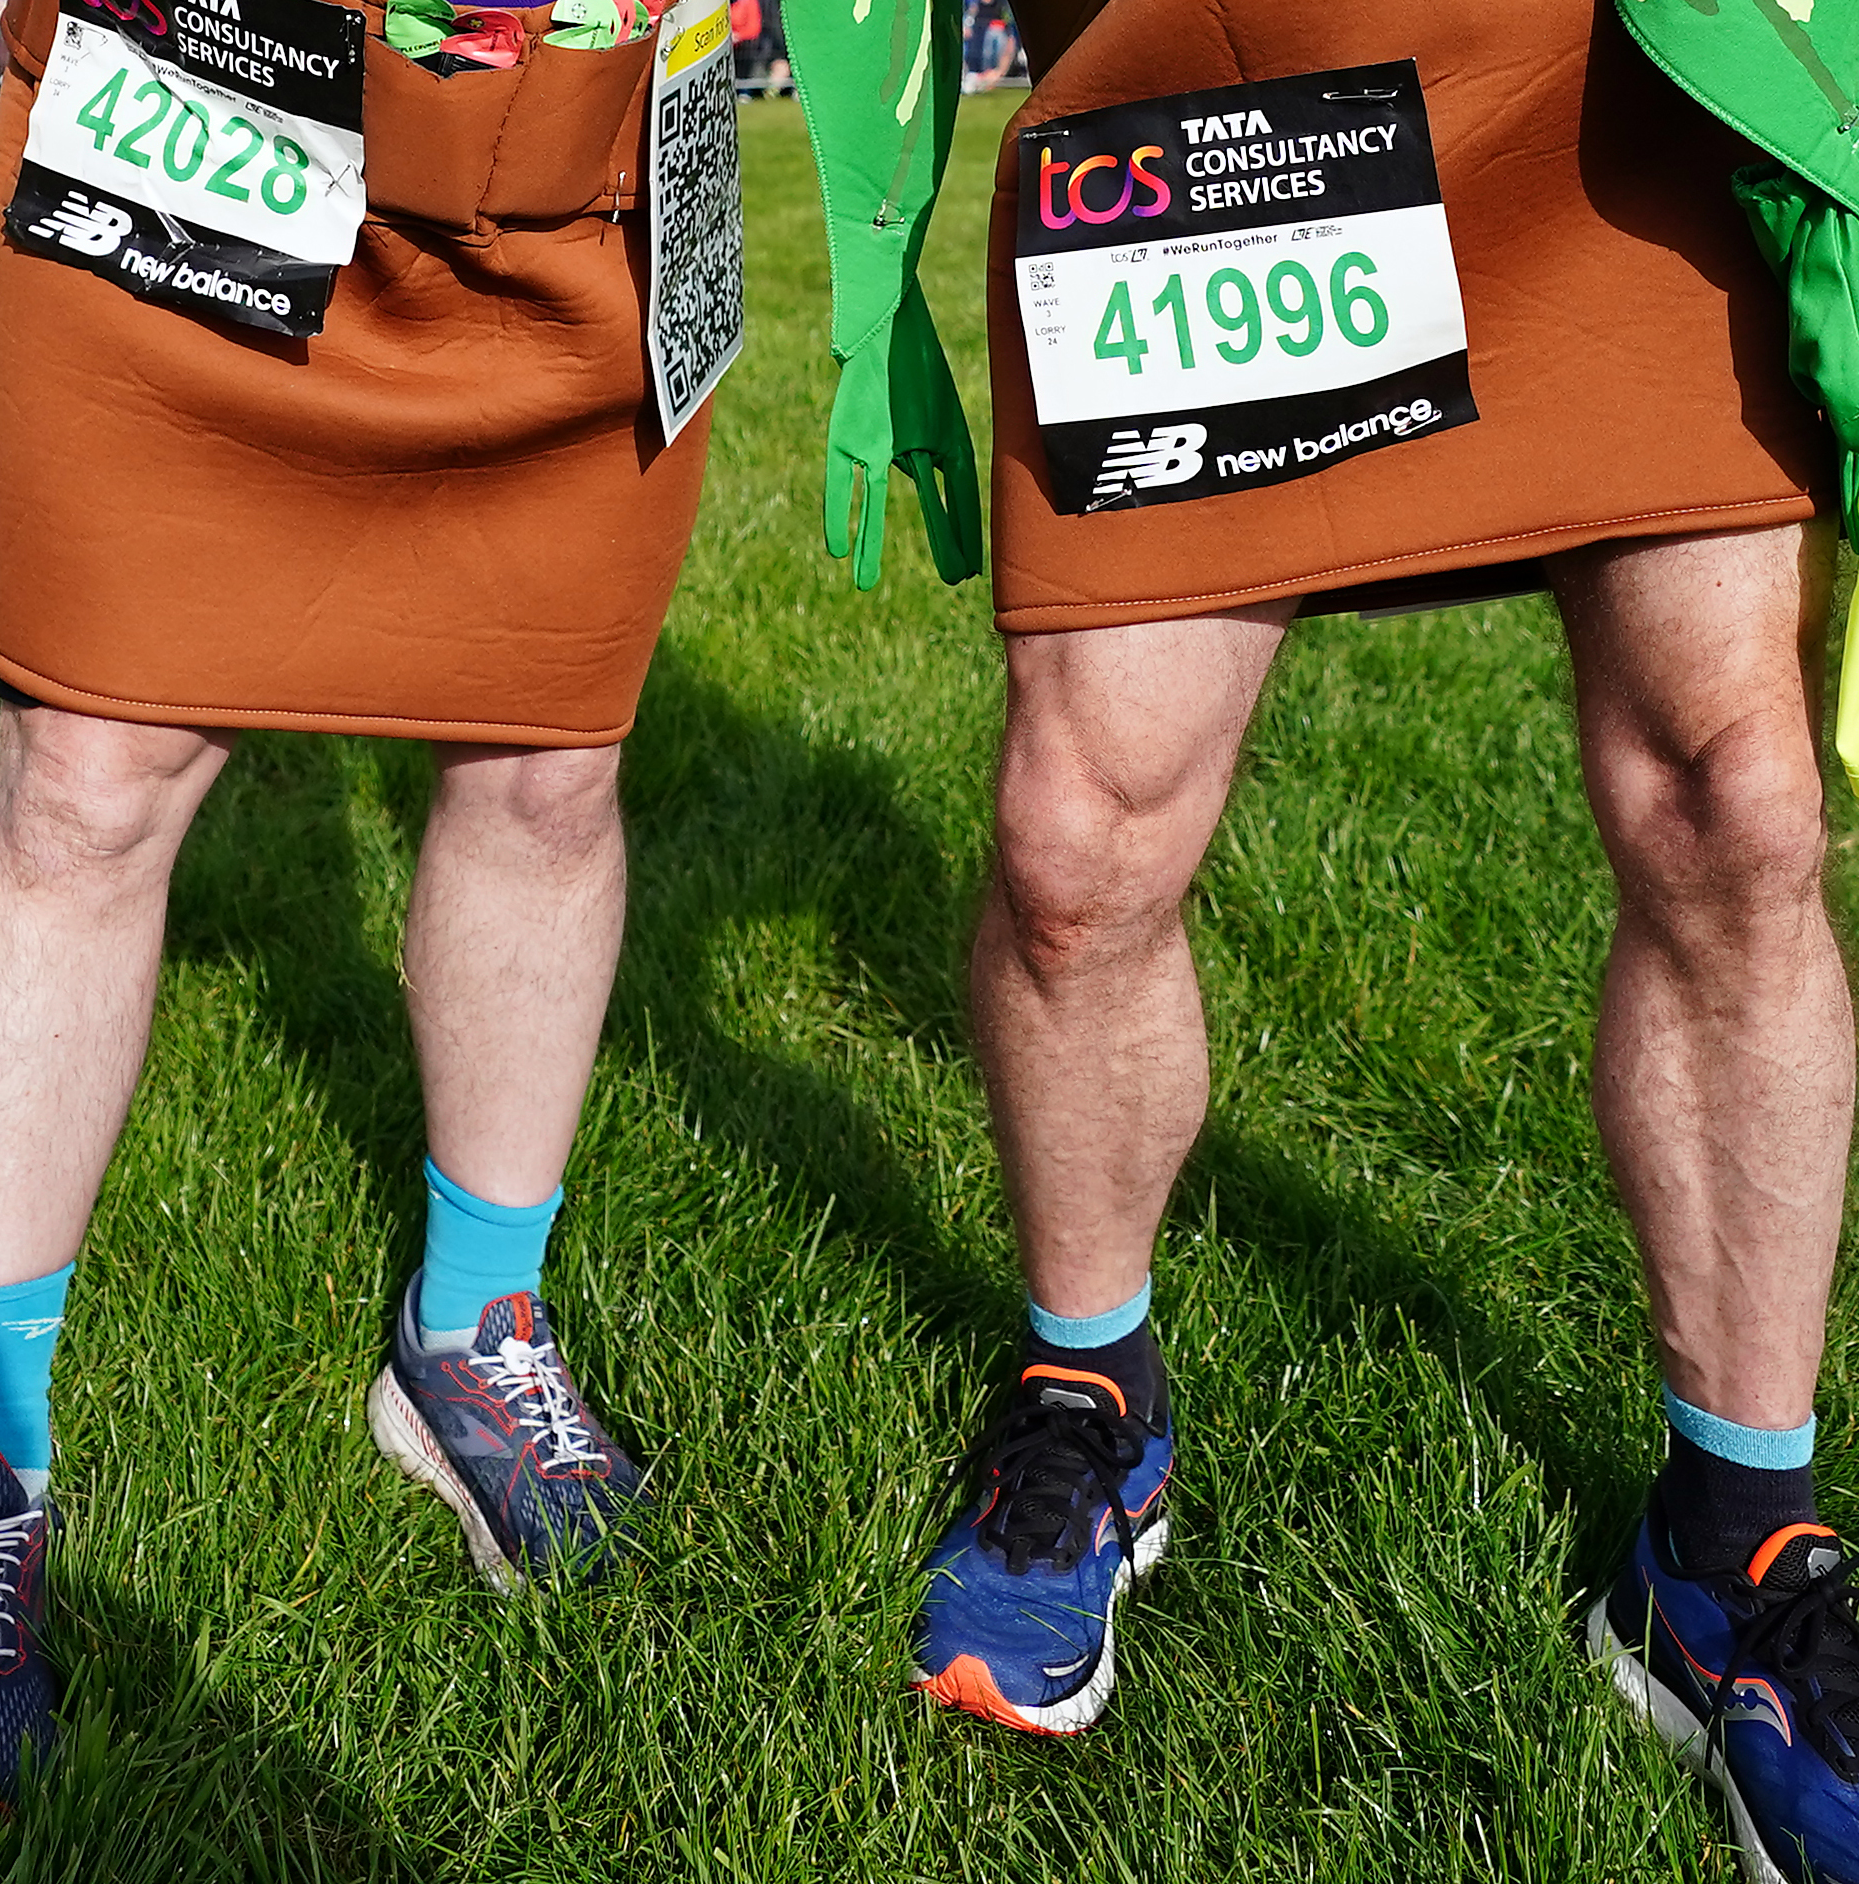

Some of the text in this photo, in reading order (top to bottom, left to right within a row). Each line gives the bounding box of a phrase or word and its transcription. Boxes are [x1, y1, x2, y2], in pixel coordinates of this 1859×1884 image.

[174, 6, 340, 80] CONSULTANCY
[176, 33, 276, 88] SERVICES
[76, 67, 310, 216] 42028
[1181, 109, 1273, 145] TATA
[1185, 124, 1399, 178] CONSULTANCY
[1040, 145, 1172, 230] tcs
[1189, 169, 1327, 212] SERVICES
[28, 190, 134, 257] NB
[1162, 232, 1279, 257] #WeRunTogether
[120, 247, 292, 316] new balance
[1092, 251, 1390, 376] 41996
[1034, 325, 1067, 336] LORRY
[1092, 423, 1208, 495] NB
[1216, 397, 1434, 478] new balance
